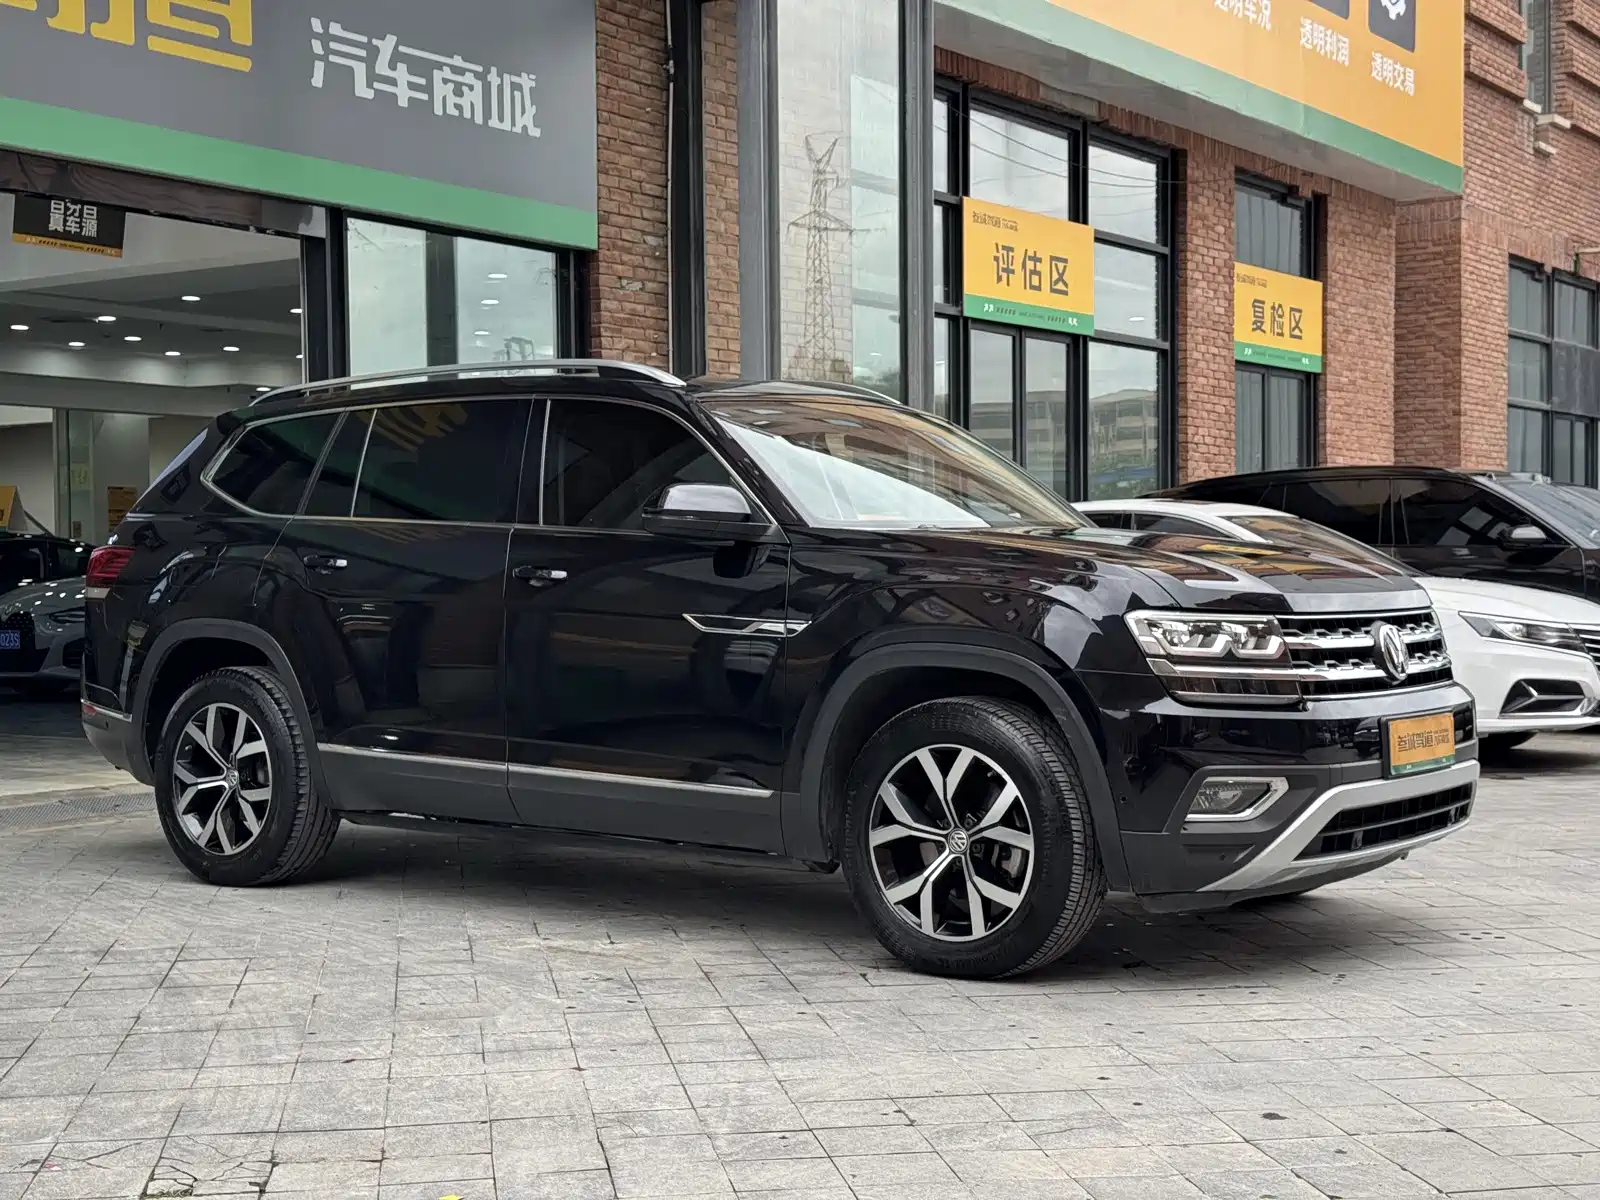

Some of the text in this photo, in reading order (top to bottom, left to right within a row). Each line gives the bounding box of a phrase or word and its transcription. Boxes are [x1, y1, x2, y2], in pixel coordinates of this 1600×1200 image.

[1300, 16, 1349, 67] 透明利润
[310, 17, 542, 138] 汽车商城
[1371, 50, 1415, 96] 透明交易
[48, 213, 98, 238] 真车源
[993, 242, 1069, 296] 评估区
[1251, 298, 1303, 340] 复检区
